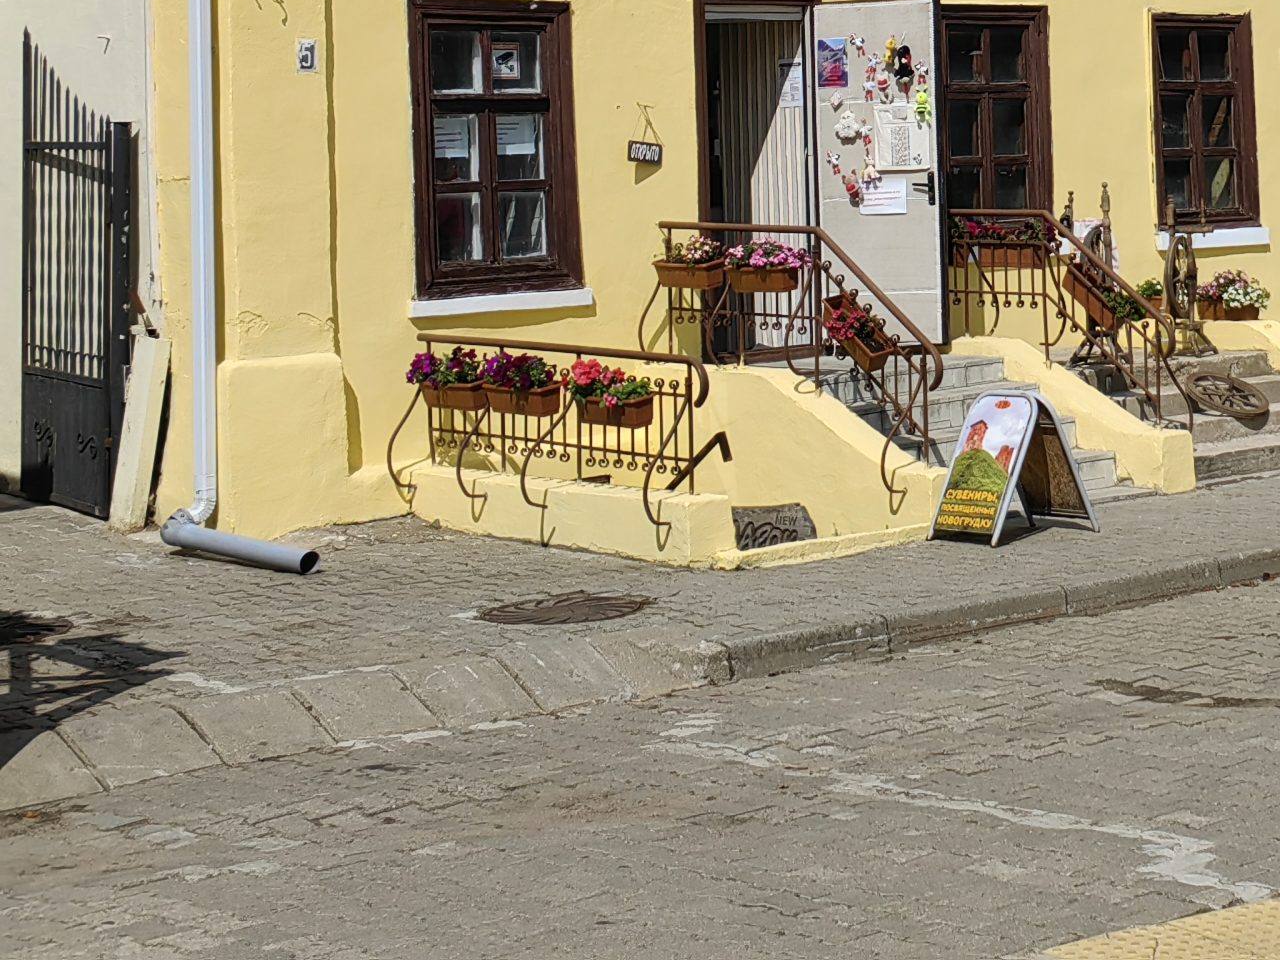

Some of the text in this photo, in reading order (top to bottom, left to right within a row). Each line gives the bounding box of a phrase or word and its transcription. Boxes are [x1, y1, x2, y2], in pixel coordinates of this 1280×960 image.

[300, 42, 312, 68] 5
[630, 143, 660, 162] ОТКРЫТО
[945, 488, 998, 503] СУВЕНИРЫ,
[775, 514, 798, 526] NEW
[936, 514, 993, 529] НОВОГРУДКУ
